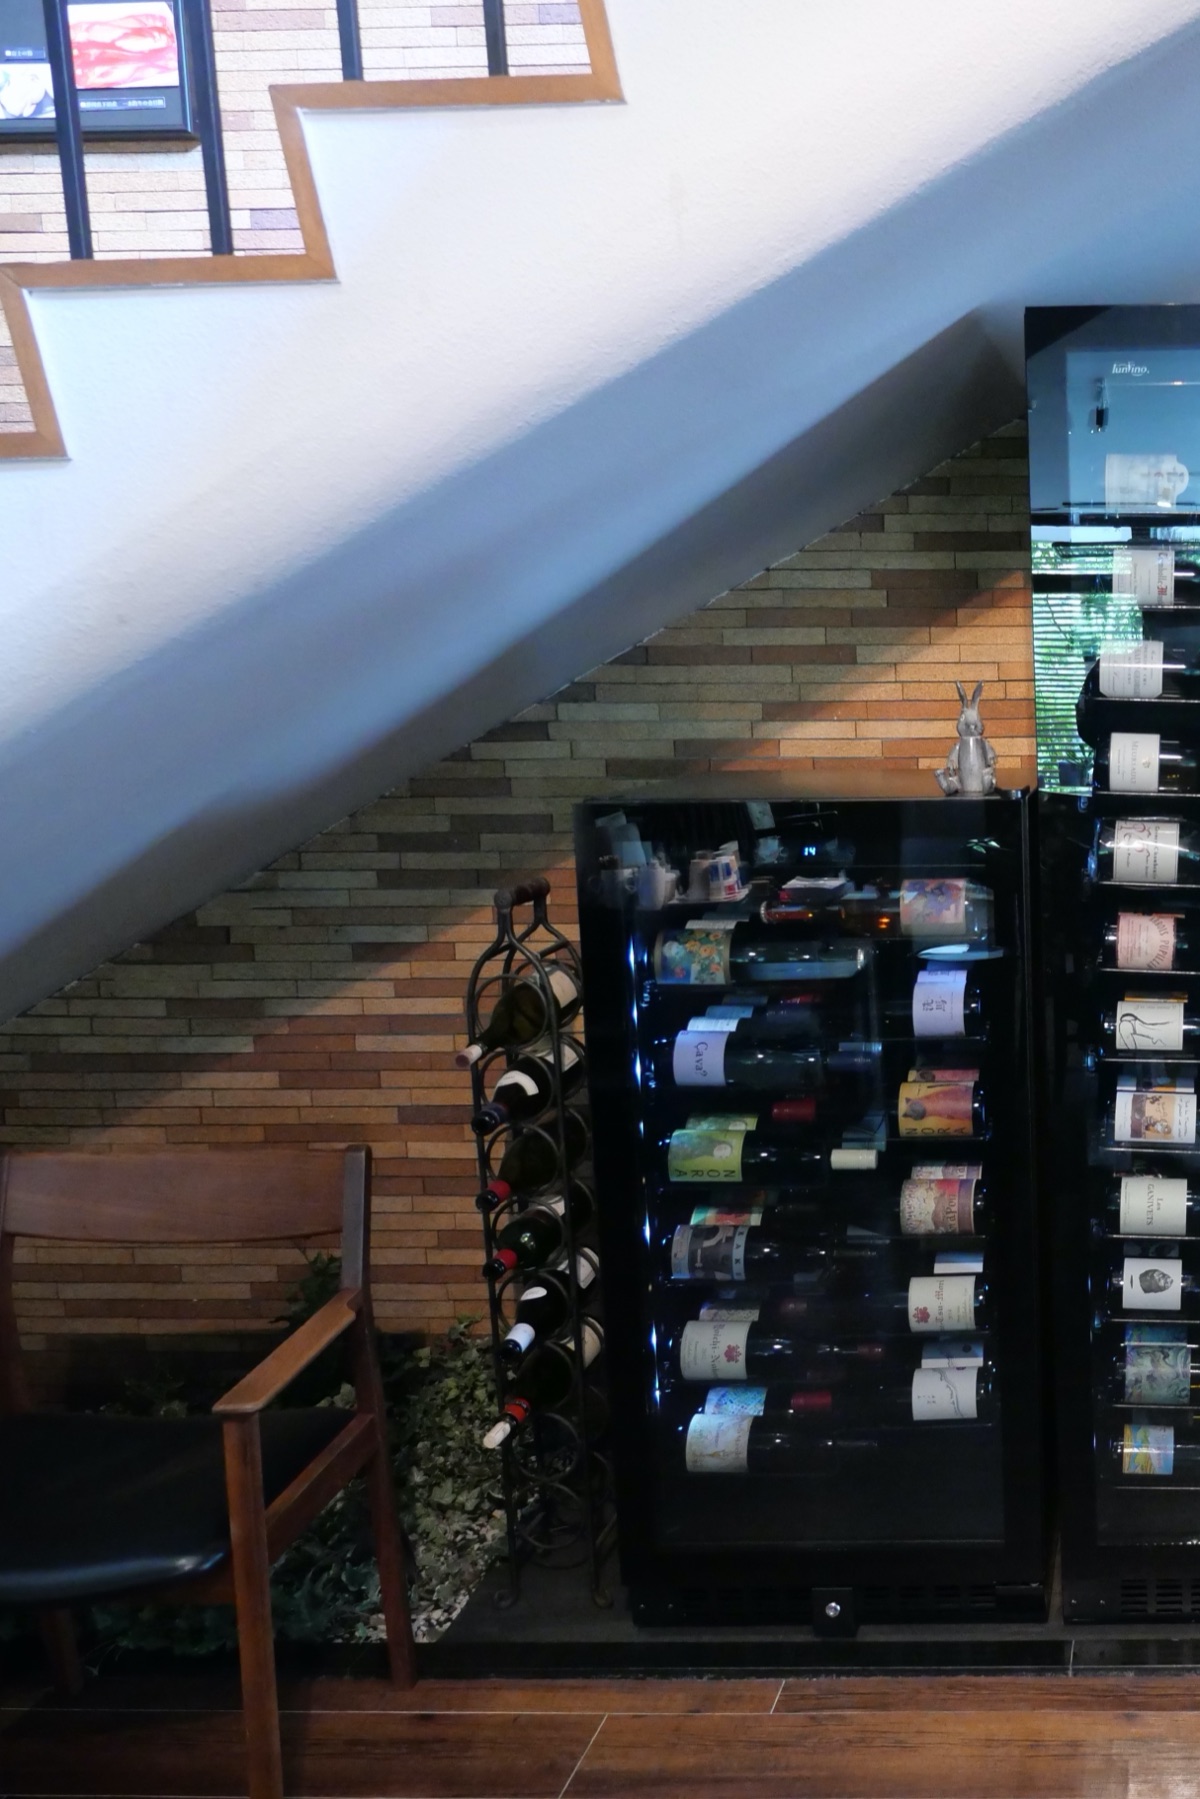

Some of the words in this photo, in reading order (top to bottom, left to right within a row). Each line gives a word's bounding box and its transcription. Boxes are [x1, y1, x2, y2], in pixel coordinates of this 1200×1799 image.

[804, 846, 816, 856] 14
[905, 1126, 967, 1135] NORA
[674, 1168, 736, 1179] NORA
[1146, 1183, 1155, 1226] GANIVETS
[934, 1279, 946, 1332] a-Tsu-Mori
